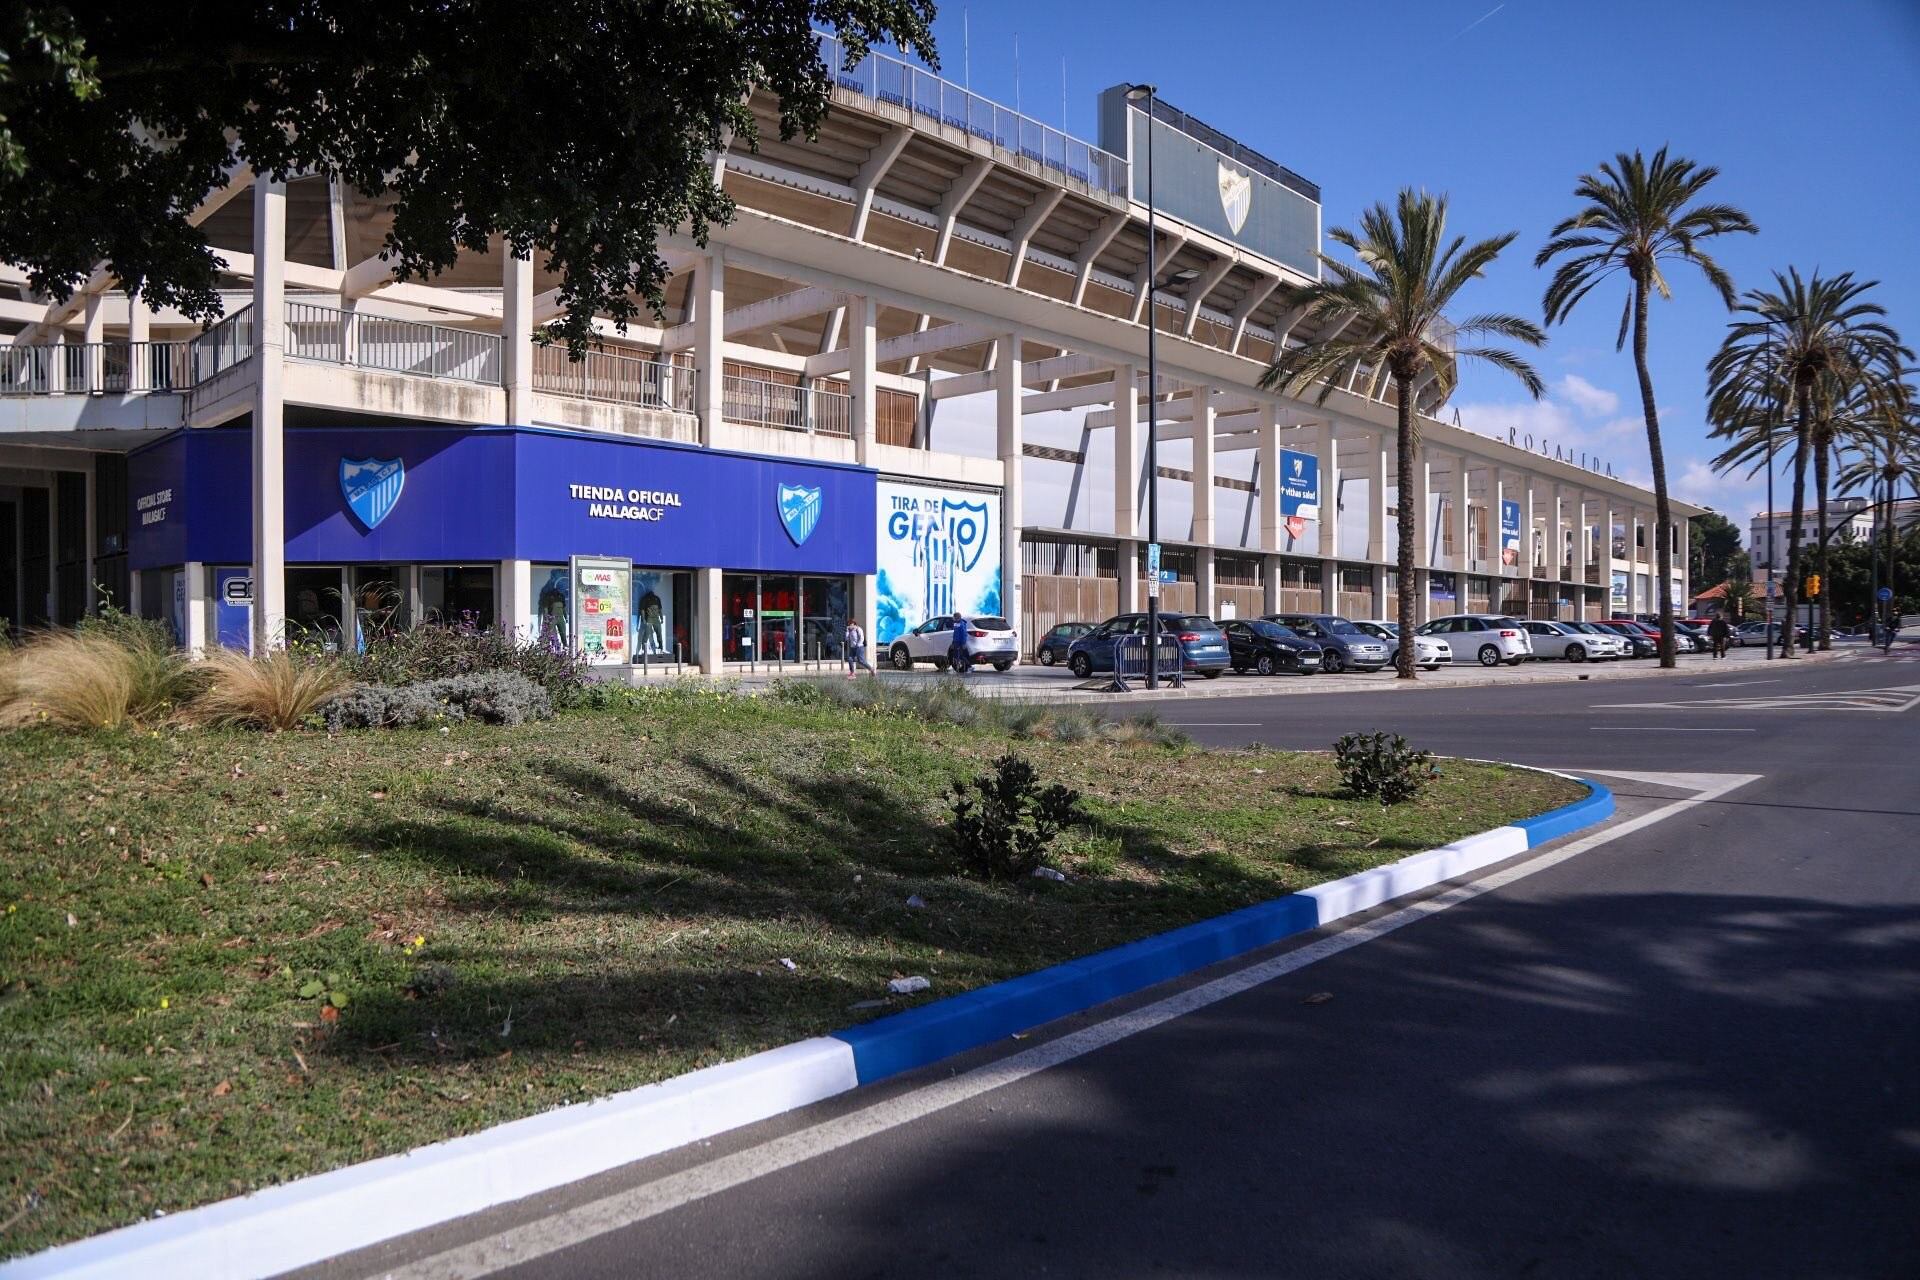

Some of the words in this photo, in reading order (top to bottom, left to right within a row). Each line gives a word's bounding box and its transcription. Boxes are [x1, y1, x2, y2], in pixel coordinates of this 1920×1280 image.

[569, 484, 624, 502] TIENDA
[627, 489, 682, 507] OFICIAL
[590, 503, 664, 521] MALAGACF
[891, 496, 919, 511] TIRA
[925, 499, 938, 513] DE
[594, 574, 611, 582] MAS
